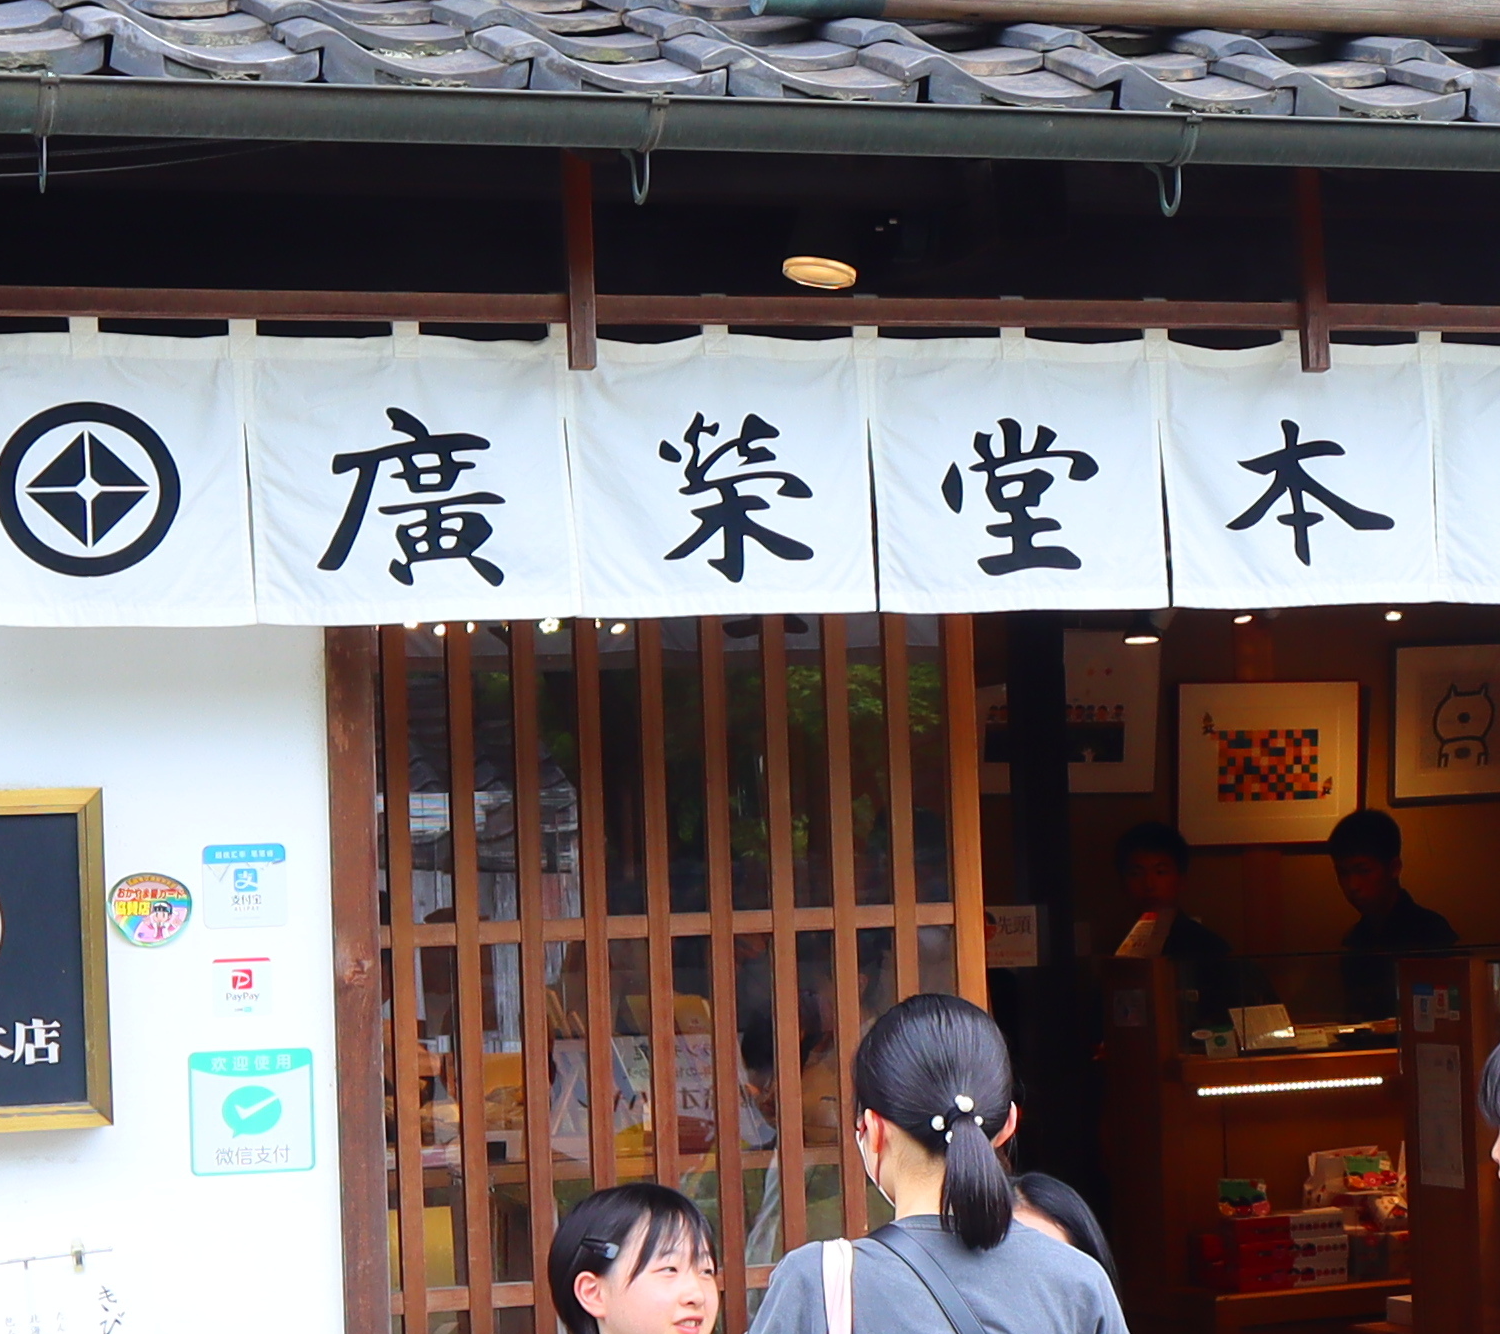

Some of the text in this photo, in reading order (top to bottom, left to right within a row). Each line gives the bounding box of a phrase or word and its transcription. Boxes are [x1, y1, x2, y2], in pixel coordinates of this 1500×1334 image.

[226, 992, 260, 1002] PayPay
[211, 1053, 292, 1072] 欢迎使用
[215, 1144, 290, 1166] 微信支付
